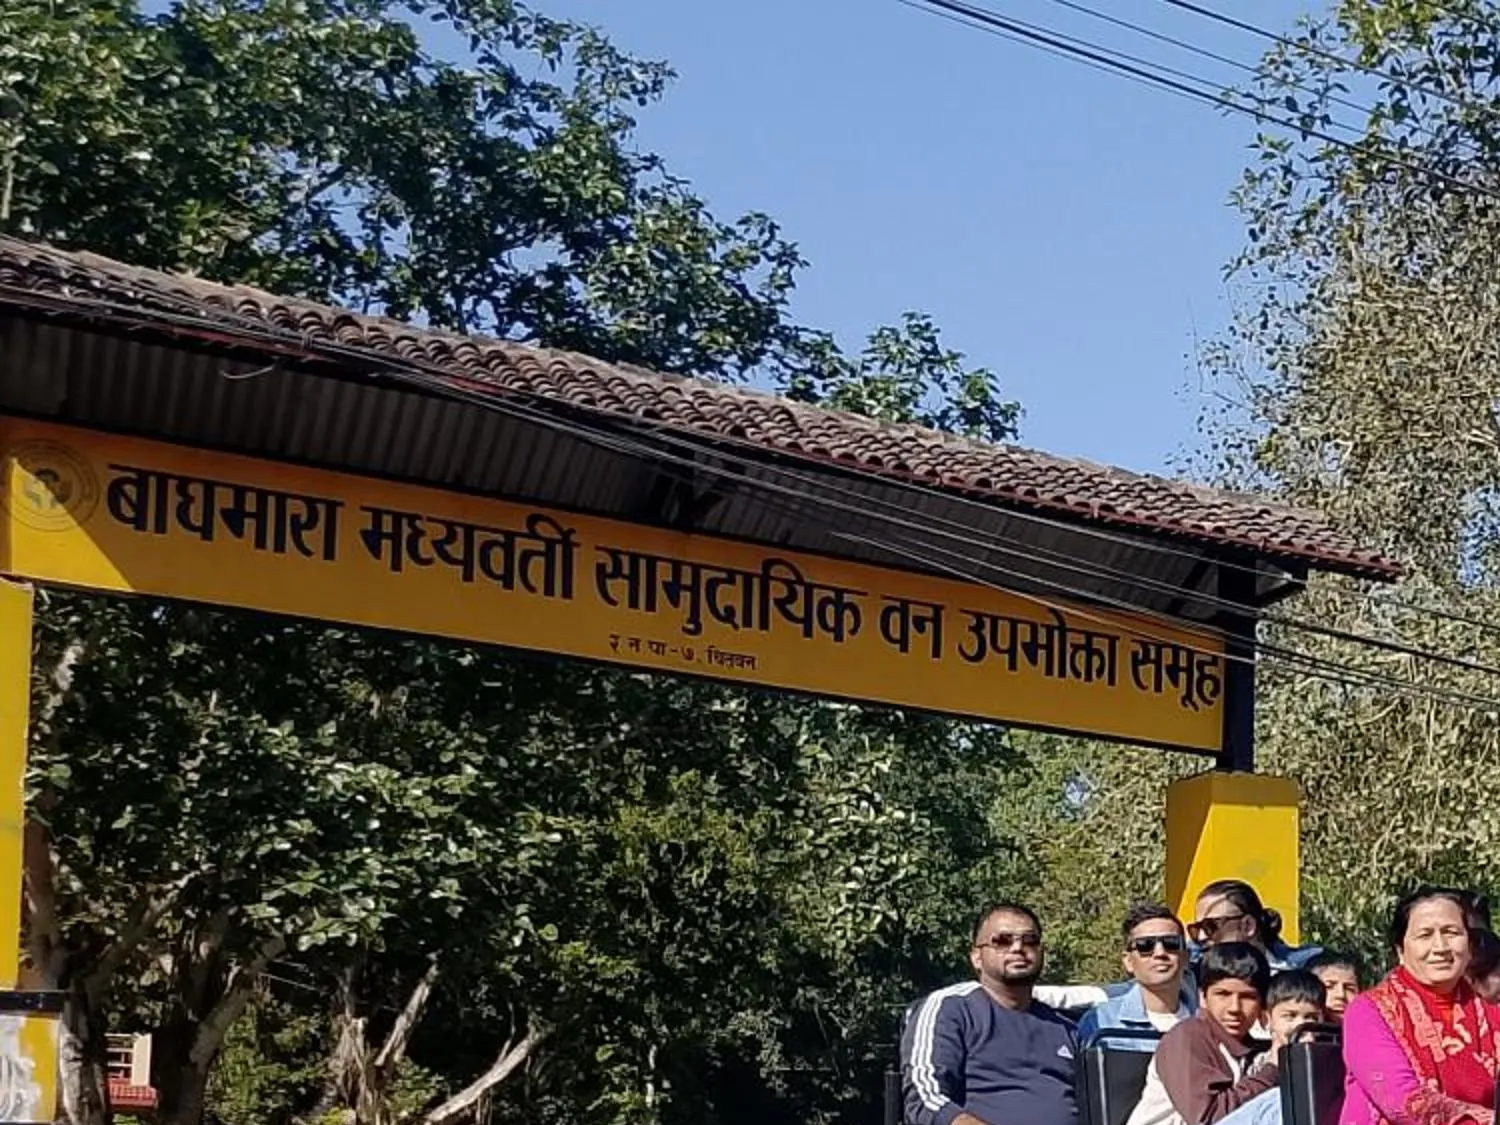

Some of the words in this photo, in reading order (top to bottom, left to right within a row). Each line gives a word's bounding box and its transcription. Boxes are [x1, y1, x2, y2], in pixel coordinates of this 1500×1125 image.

[106, 463, 344, 561] बाघमारा
[359, 503, 582, 600] मध्यवर्ती
[594, 545, 868, 642] सामुदायिक
[879, 595, 945, 659] वन
[957, 607, 1121, 687] उपभोक्ता
[1130, 637, 1222, 712] समूह
